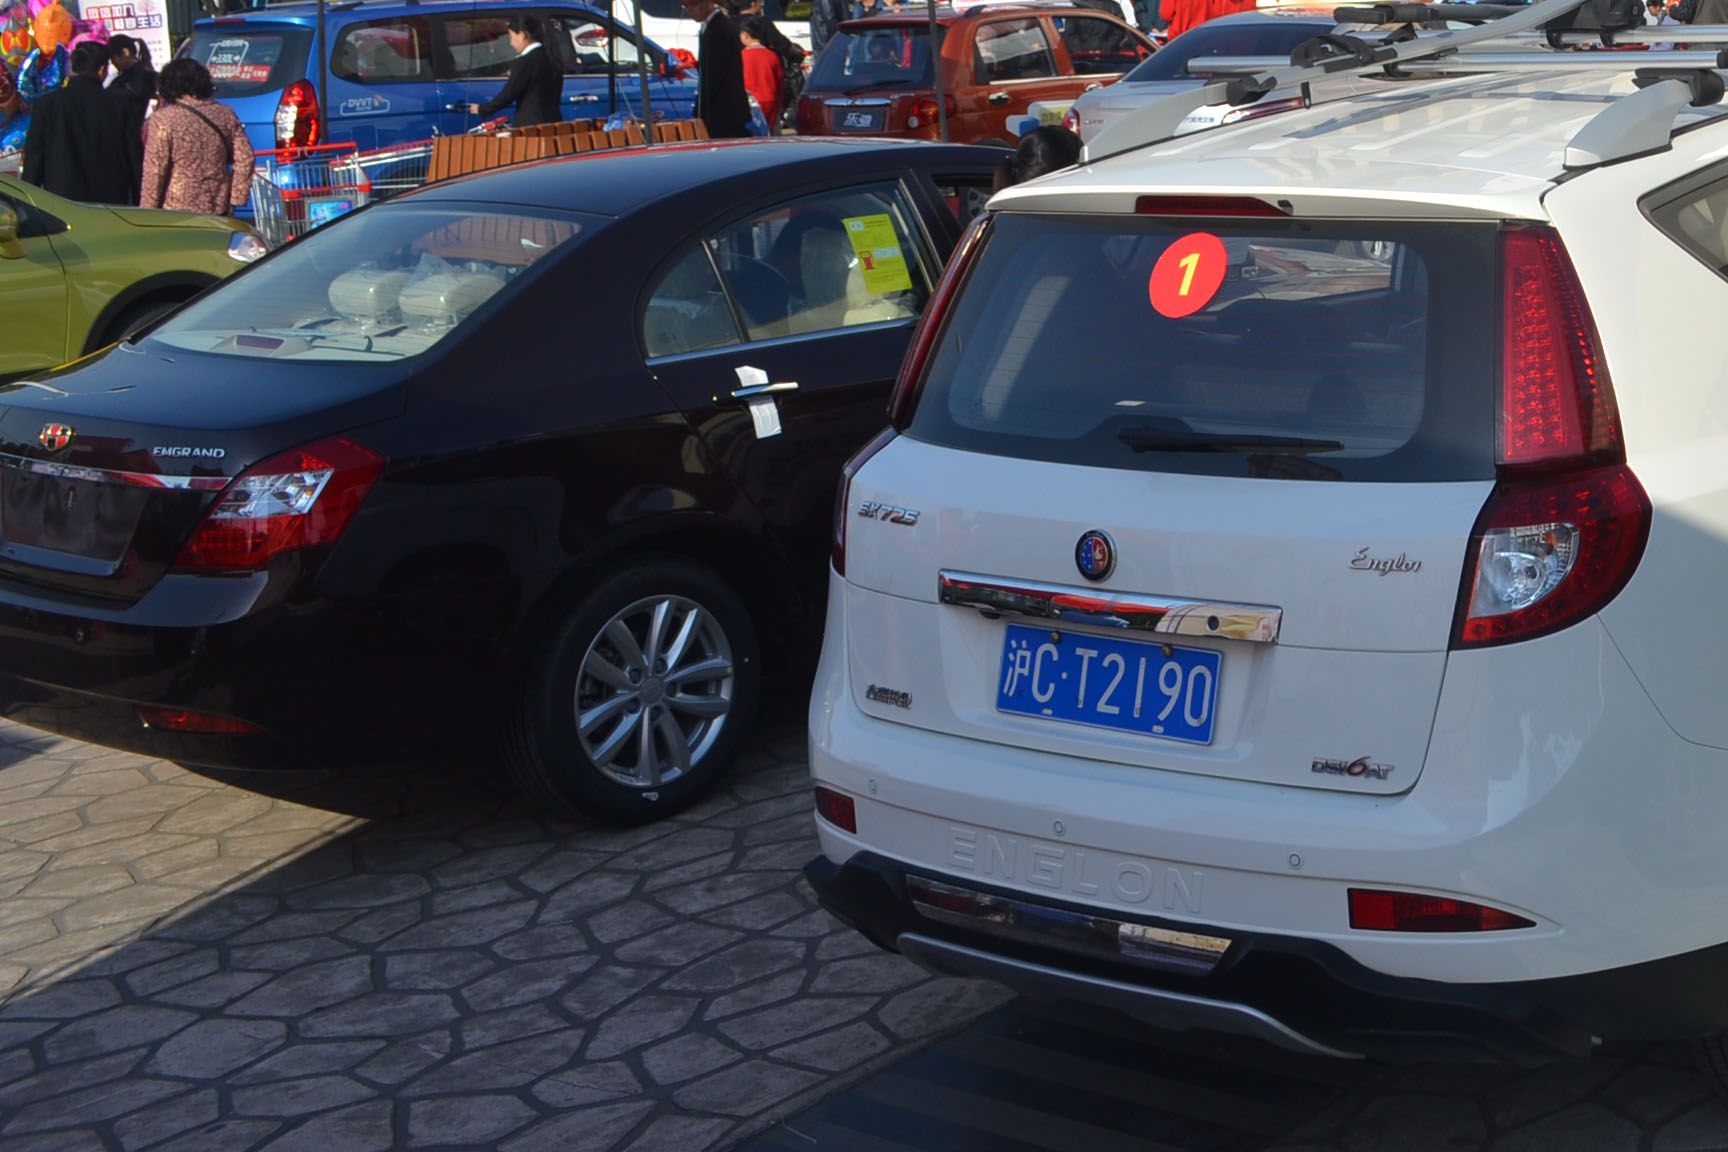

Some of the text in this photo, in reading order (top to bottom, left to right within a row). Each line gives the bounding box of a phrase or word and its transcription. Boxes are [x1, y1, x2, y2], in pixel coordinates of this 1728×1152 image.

[1177, 253, 1201, 297] 1
[152, 446, 226, 459] EMGRAND
[949, 825, 1205, 914] ENGLON
